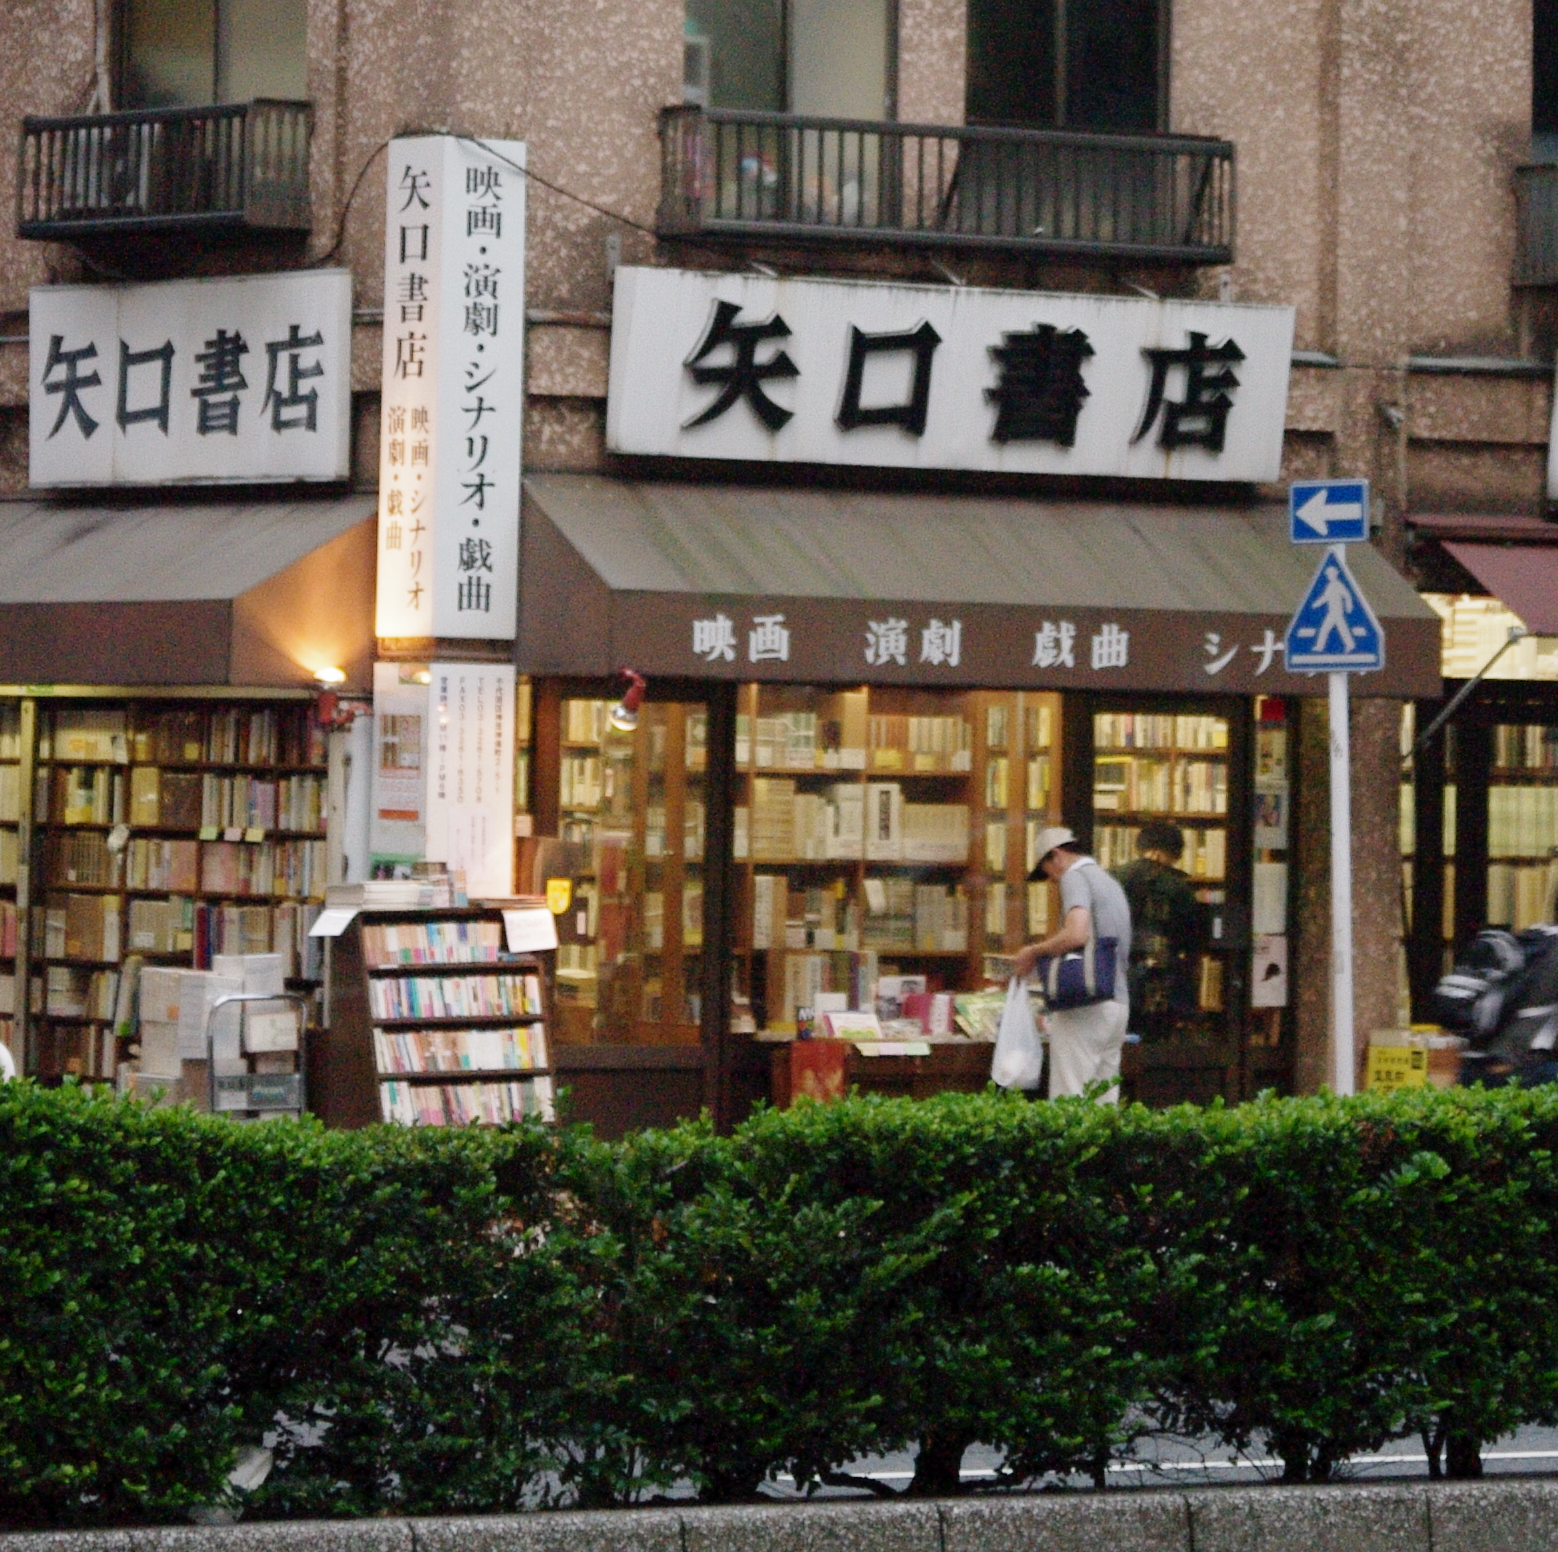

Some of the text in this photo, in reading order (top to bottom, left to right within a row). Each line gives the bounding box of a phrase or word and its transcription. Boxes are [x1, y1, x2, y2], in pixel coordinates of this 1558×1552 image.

[393, 163, 431, 380] 矢口書店
[41, 326, 325, 440] 矢口書店
[457, 164, 503, 613] 映画・演劇・シナリオ・戯曲
[681, 298, 1246, 452] 矢口書店
[692, 614, 791, 663] 映画
[864, 619, 963, 667] 演劇
[1030, 622, 1130, 670] 戯曲
